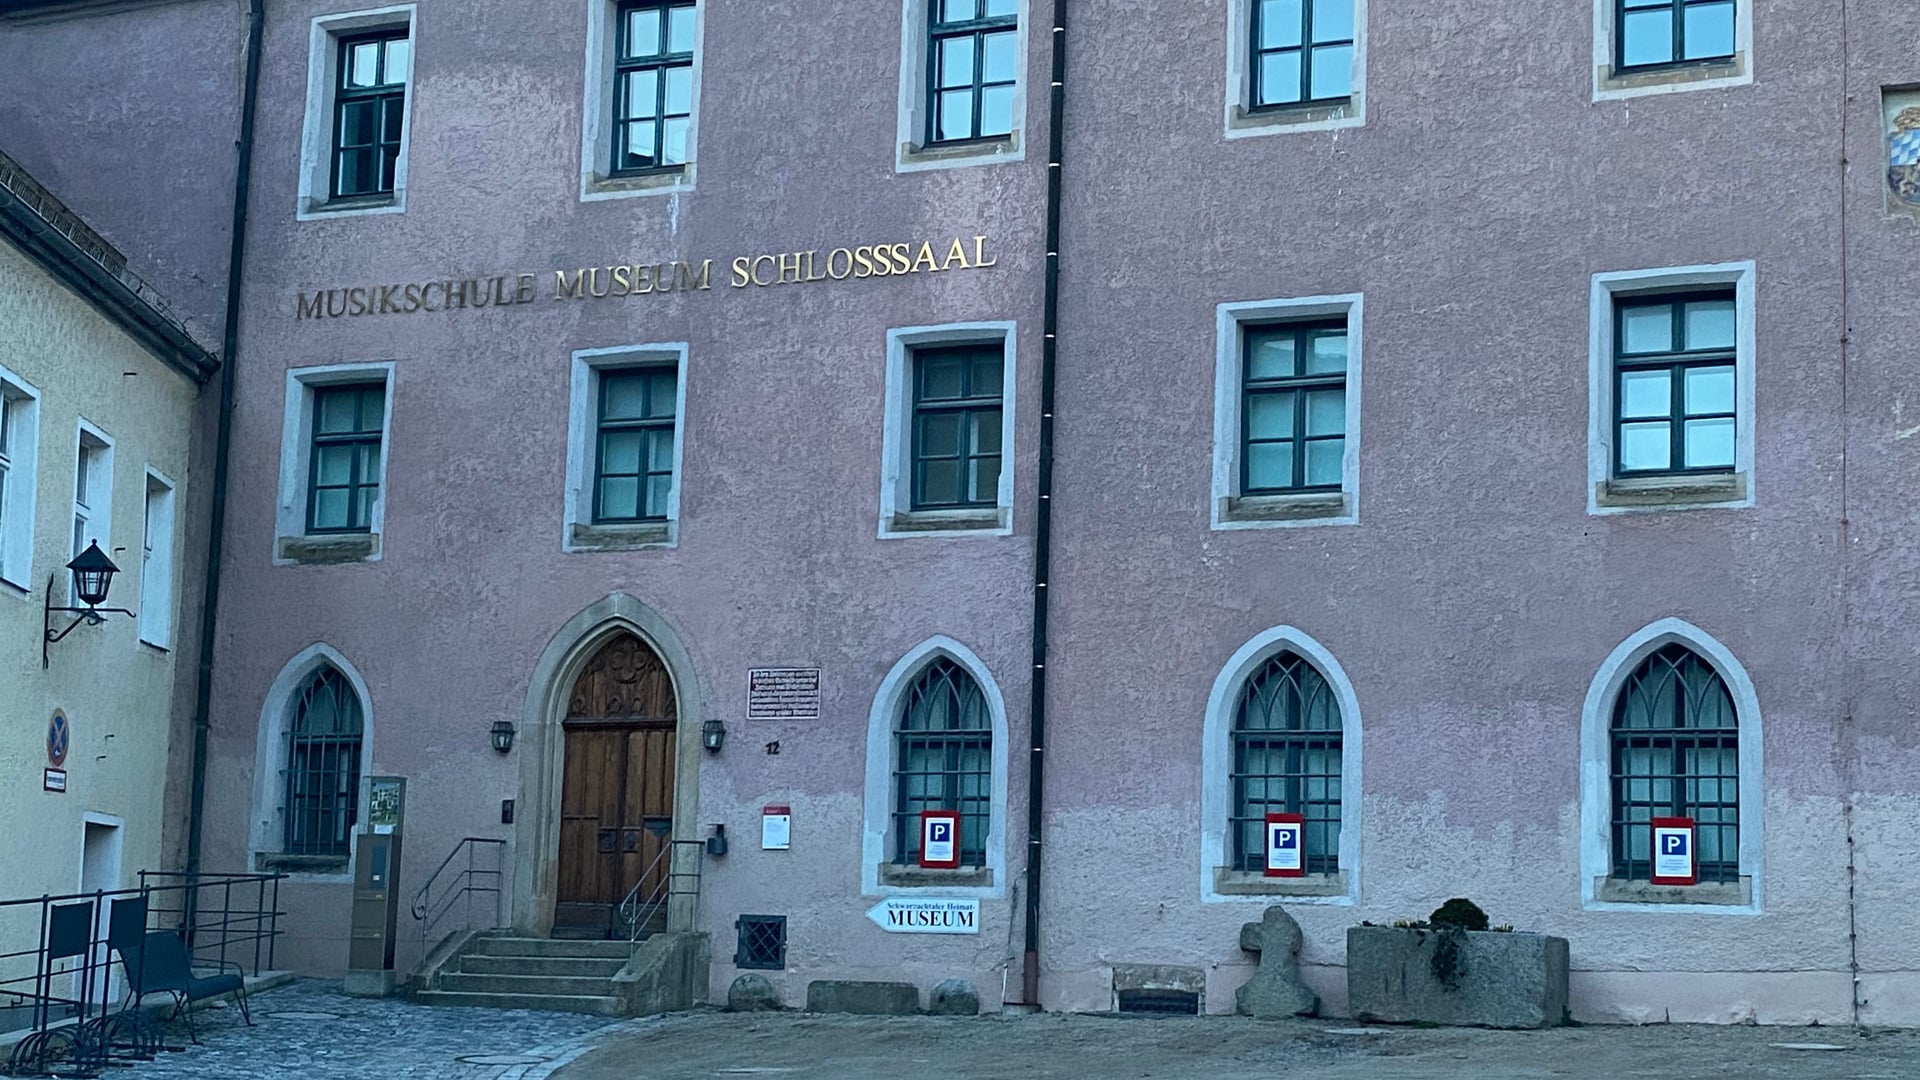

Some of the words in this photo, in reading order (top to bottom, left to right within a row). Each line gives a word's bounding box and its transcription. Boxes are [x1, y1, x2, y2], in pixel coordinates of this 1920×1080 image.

[297, 272, 536, 321] MUSIKSCHULE
[554, 258, 713, 301] MUSEUM
[730, 235, 998, 289] SCHLOSSSAAL
[765, 740, 780, 755] 12
[934, 825, 945, 841] P
[1279, 830, 1291, 847] P
[1667, 836, 1681, 854] P
[887, 910, 974, 927] MUSEUM
